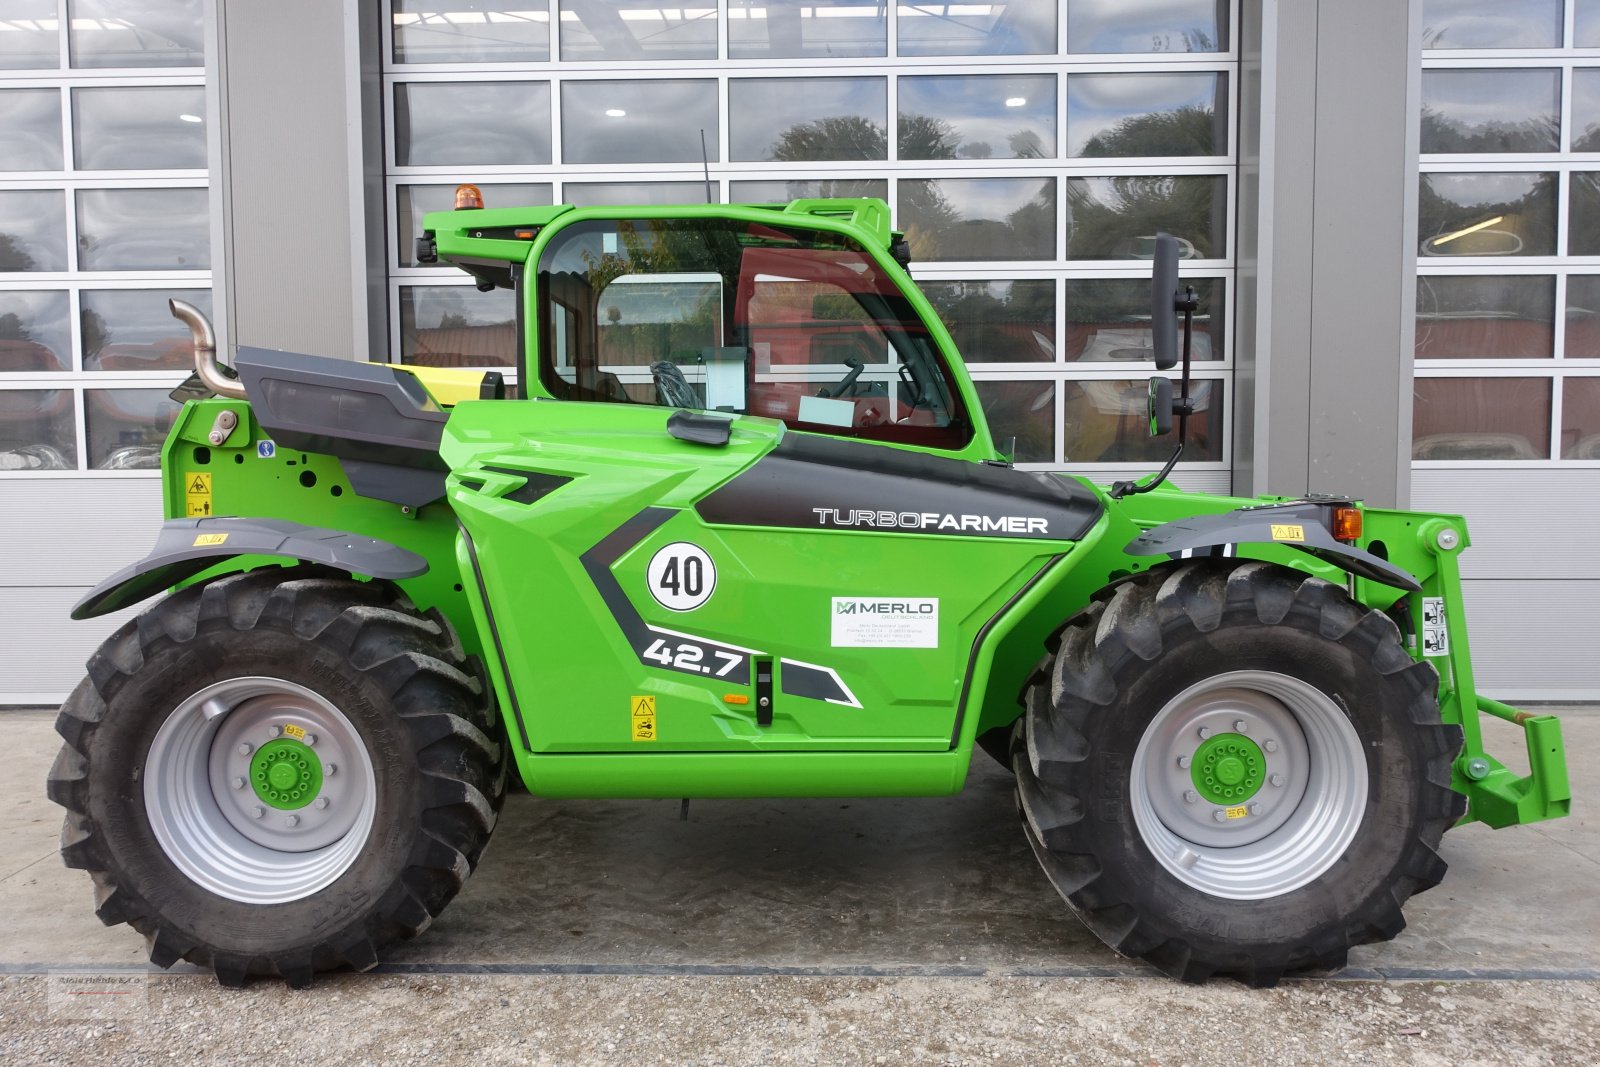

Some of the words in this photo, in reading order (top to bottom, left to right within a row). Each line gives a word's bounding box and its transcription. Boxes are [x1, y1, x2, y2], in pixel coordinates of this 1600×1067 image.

[812, 507, 1049, 533] TURBOFARMER
[660, 555, 704, 597] 40
[860, 603, 933, 614] MERLO
[642, 639, 743, 677] 42.7
